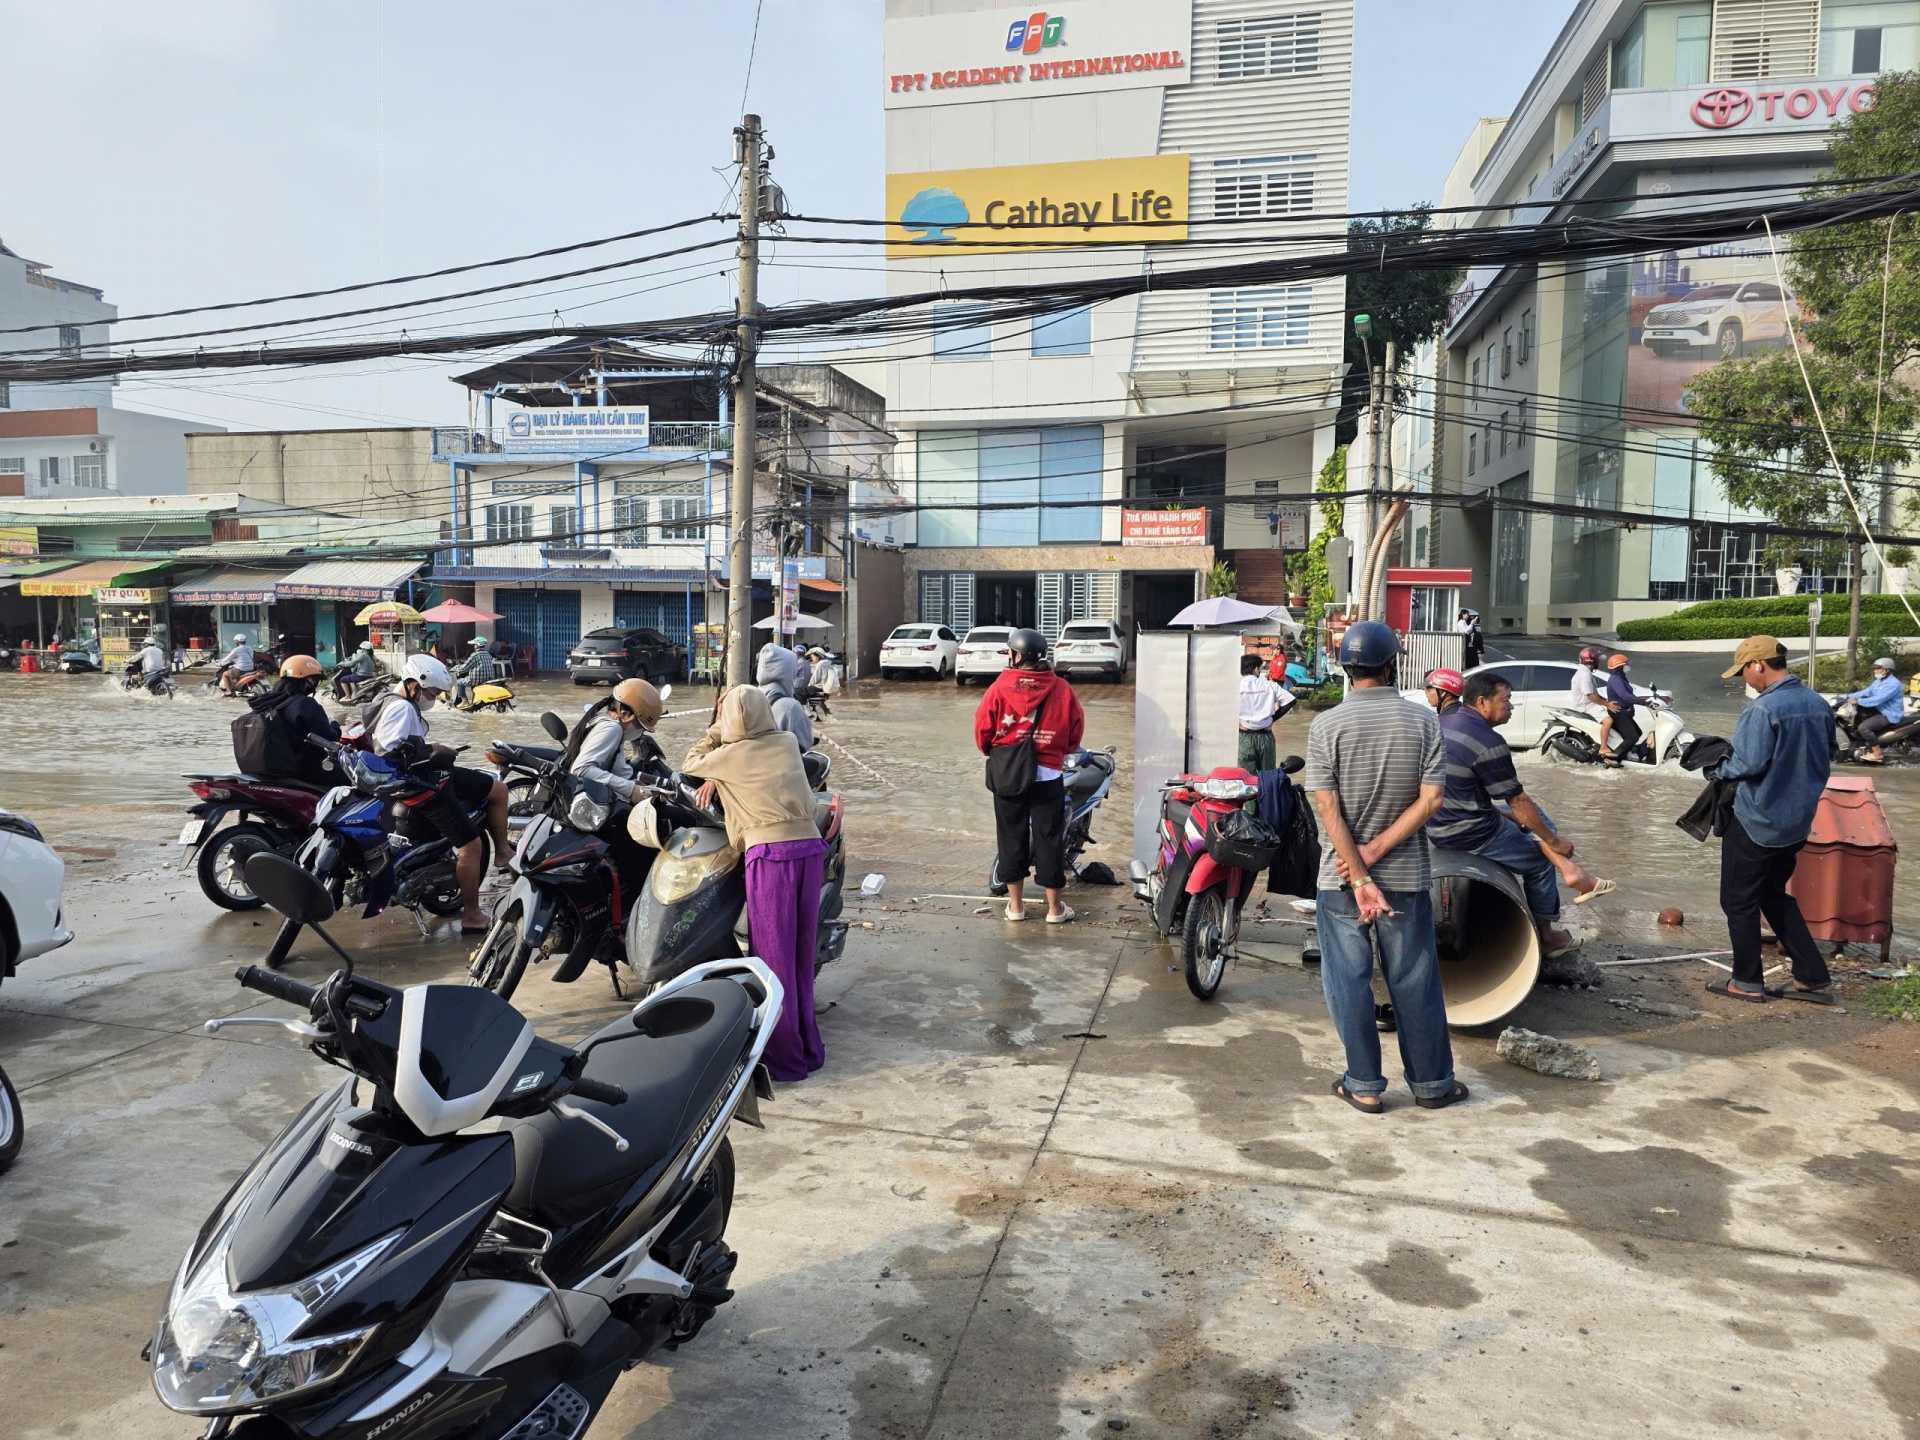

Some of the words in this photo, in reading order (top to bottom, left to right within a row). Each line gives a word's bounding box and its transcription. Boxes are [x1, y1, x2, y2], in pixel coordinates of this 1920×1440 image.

[890, 73, 925, 92] FPT
[930, 65, 1024, 89] ACADEMY
[1029, 51, 1184, 81] INTERNATIONAL
[1757, 85, 1877, 120] TOYO
[985, 197, 1102, 232] Cathay
[1112, 190, 1172, 222] Life
[533, 414, 548, 428] ĐẠI
[562, 411, 587, 425] HÀNG
[607, 409, 626, 425] CẦN
[626, 412, 645, 425] THƠ
[1181, 511, 1202, 522] PHÚC
[1130, 527, 1143, 535] CHO
[101, 590, 117, 598] VỊT
[120, 589, 146, 598] QUAY
[515, 1073, 541, 1088] FI
[330, 1131, 373, 1155] HONDA
[366, 1391, 434, 1440] HONDA
